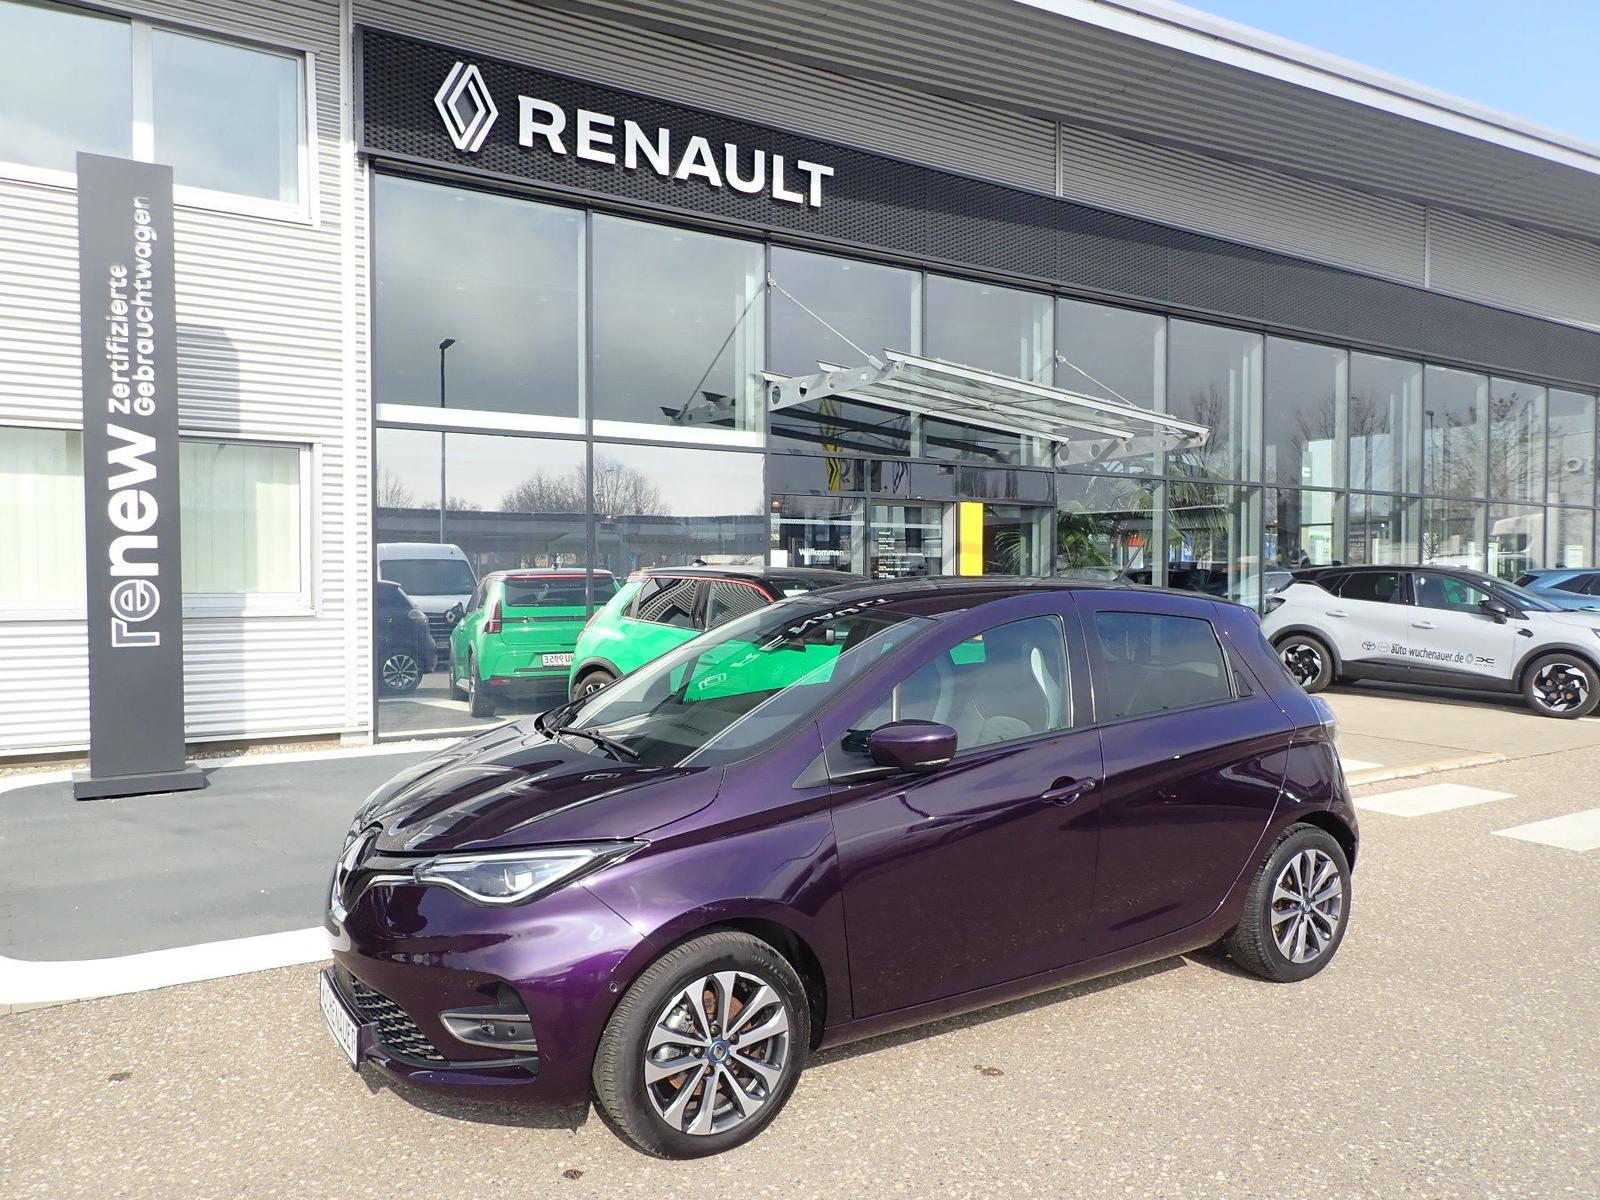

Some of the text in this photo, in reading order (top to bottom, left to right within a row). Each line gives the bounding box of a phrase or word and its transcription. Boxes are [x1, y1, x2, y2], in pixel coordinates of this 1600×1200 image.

[518, 95, 834, 208] RENAULT
[106, 263, 130, 414] Zertifizierte
[132, 196, 157, 416] Gebrauchtwagen
[107, 423, 160, 647] renew
[798, 547, 844, 556] Willkommen
